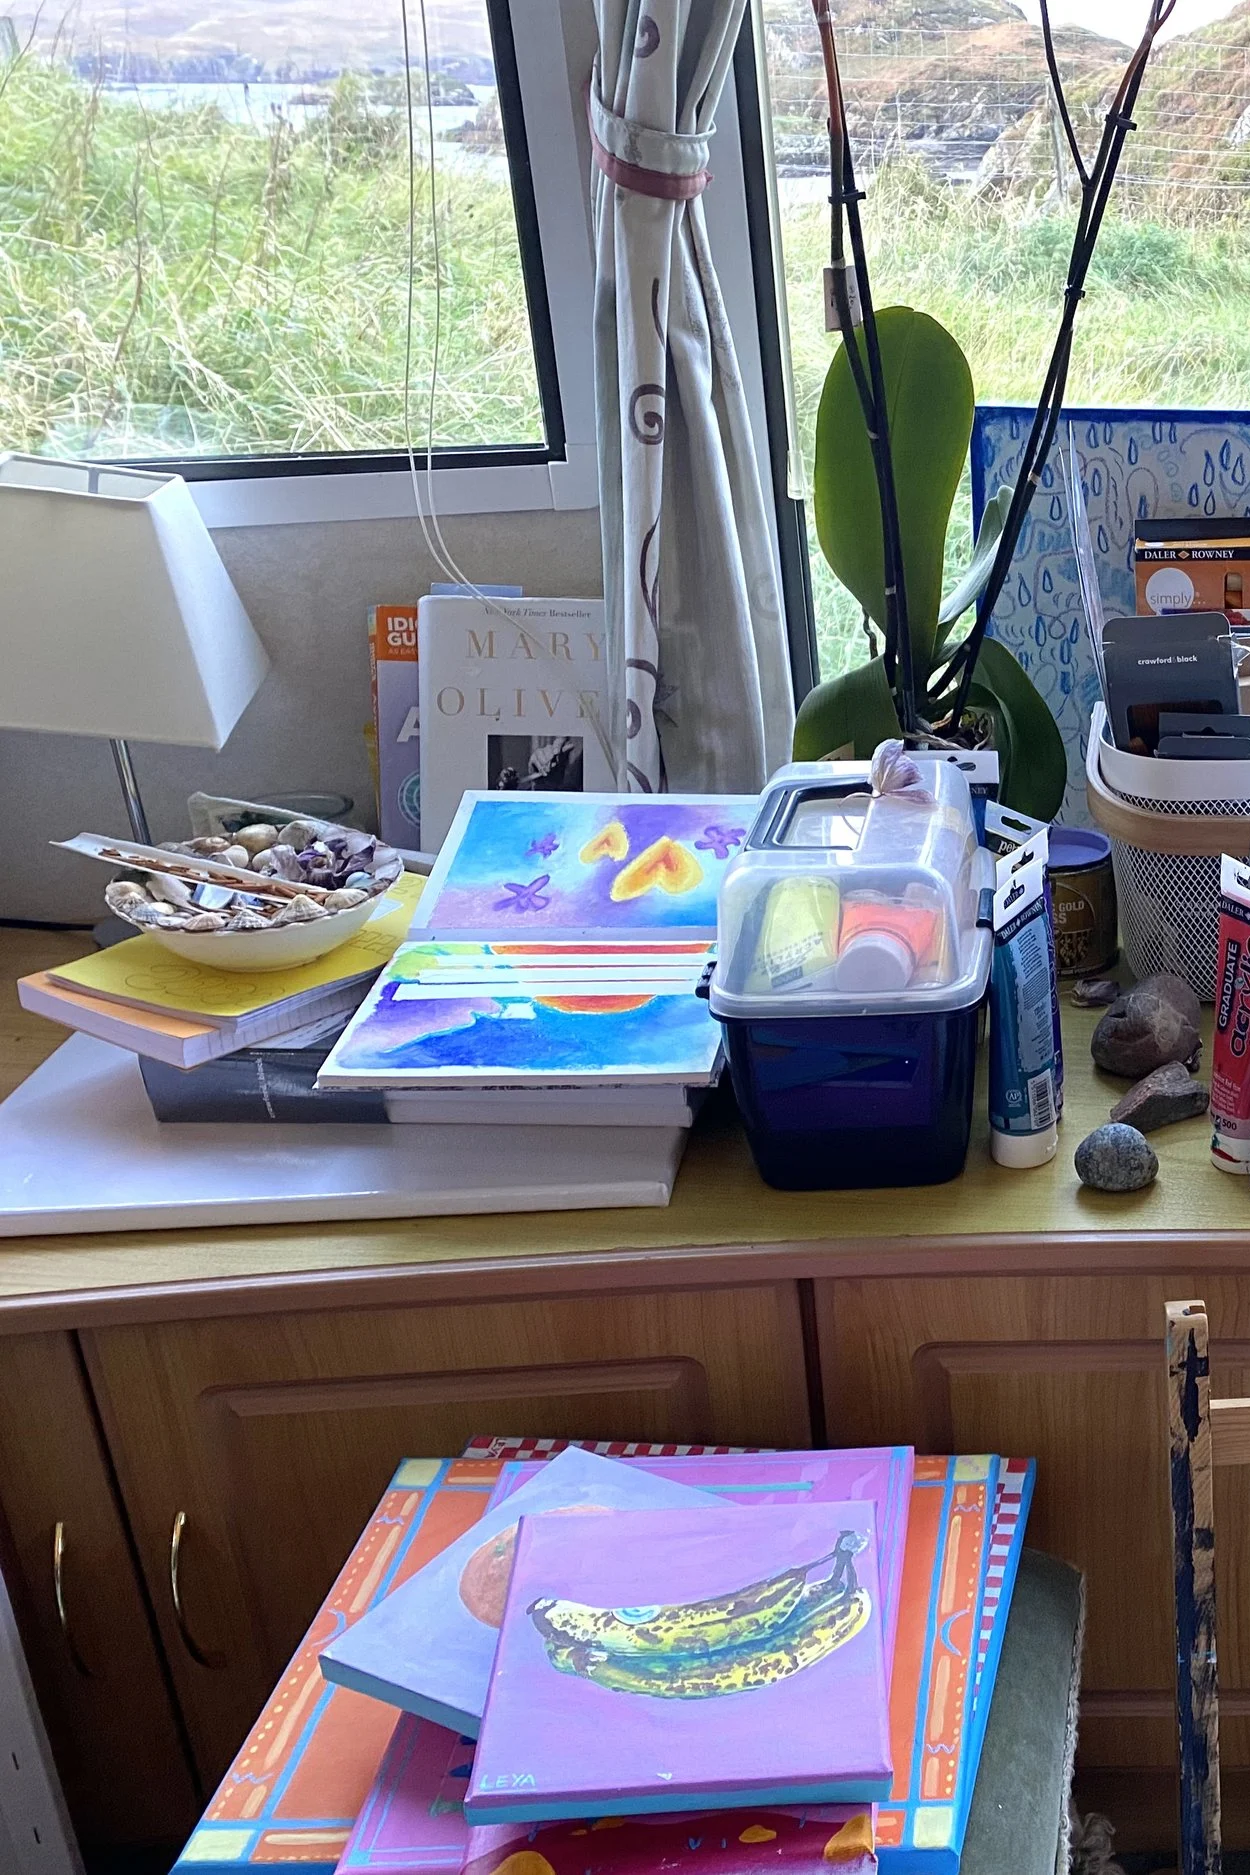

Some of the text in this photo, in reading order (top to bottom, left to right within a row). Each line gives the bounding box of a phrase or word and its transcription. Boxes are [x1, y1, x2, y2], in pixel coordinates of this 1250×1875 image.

[1144, 550, 1234, 559] DALER ROWNEY
[549, 608, 592, 618] Bestseller
[387, 616, 418, 631] IDI
[387, 631, 417, 646] GU
[465, 629, 607, 661] MARY
[1138, 657, 1171, 665] crawford
[1177, 655, 1198, 663] black
[1059, 900, 1085, 912] GOLD
[1221, 900, 1244, 918] DALER
[1001, 900, 1044, 939] DALER ROWNEY
[1217, 941, 1239, 1029] GRADUATE
[1222, 1118, 1237, 1131] 500
[480, 1774, 536, 1790] LEYA
